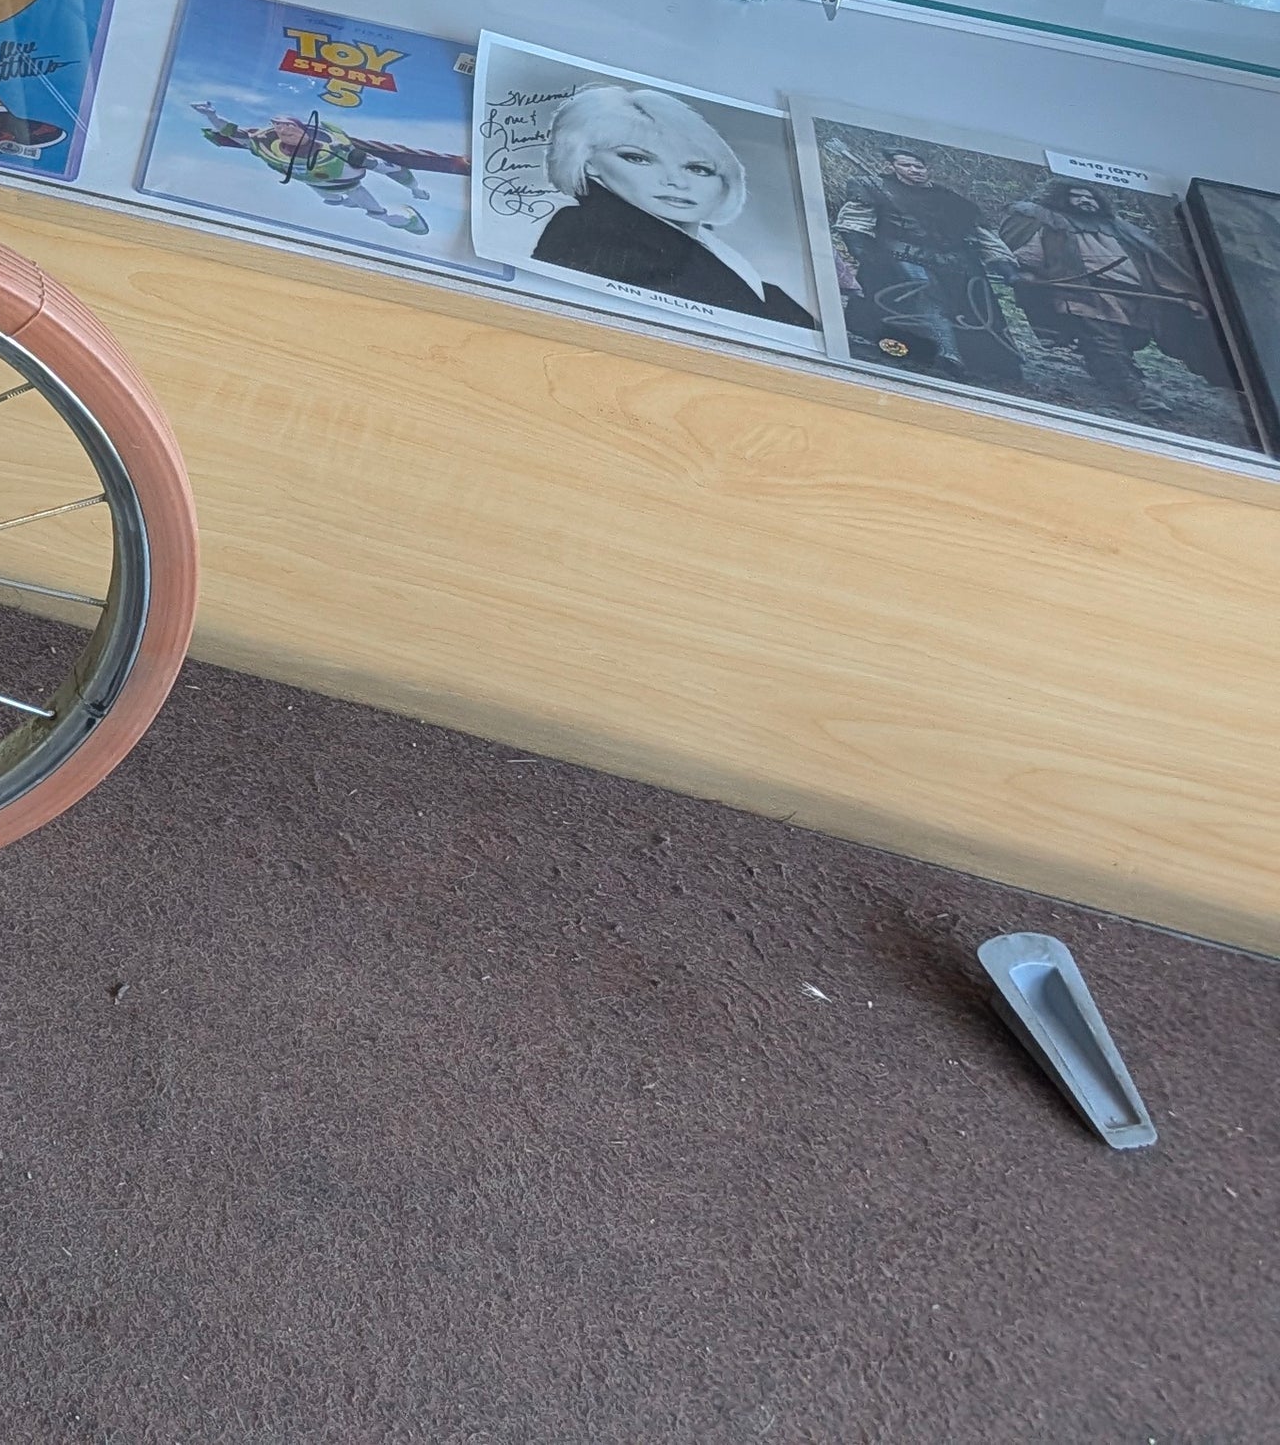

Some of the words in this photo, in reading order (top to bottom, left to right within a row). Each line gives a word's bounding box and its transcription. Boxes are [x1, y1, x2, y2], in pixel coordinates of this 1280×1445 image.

[283, 26, 411, 73] TOY
[292, 57, 387, 86] STORY
[318, 78, 363, 108] 5
[480, 109, 530, 138] Love
[605, 281, 642, 297] ANN
[648, 292, 716, 316] JILLIAN
